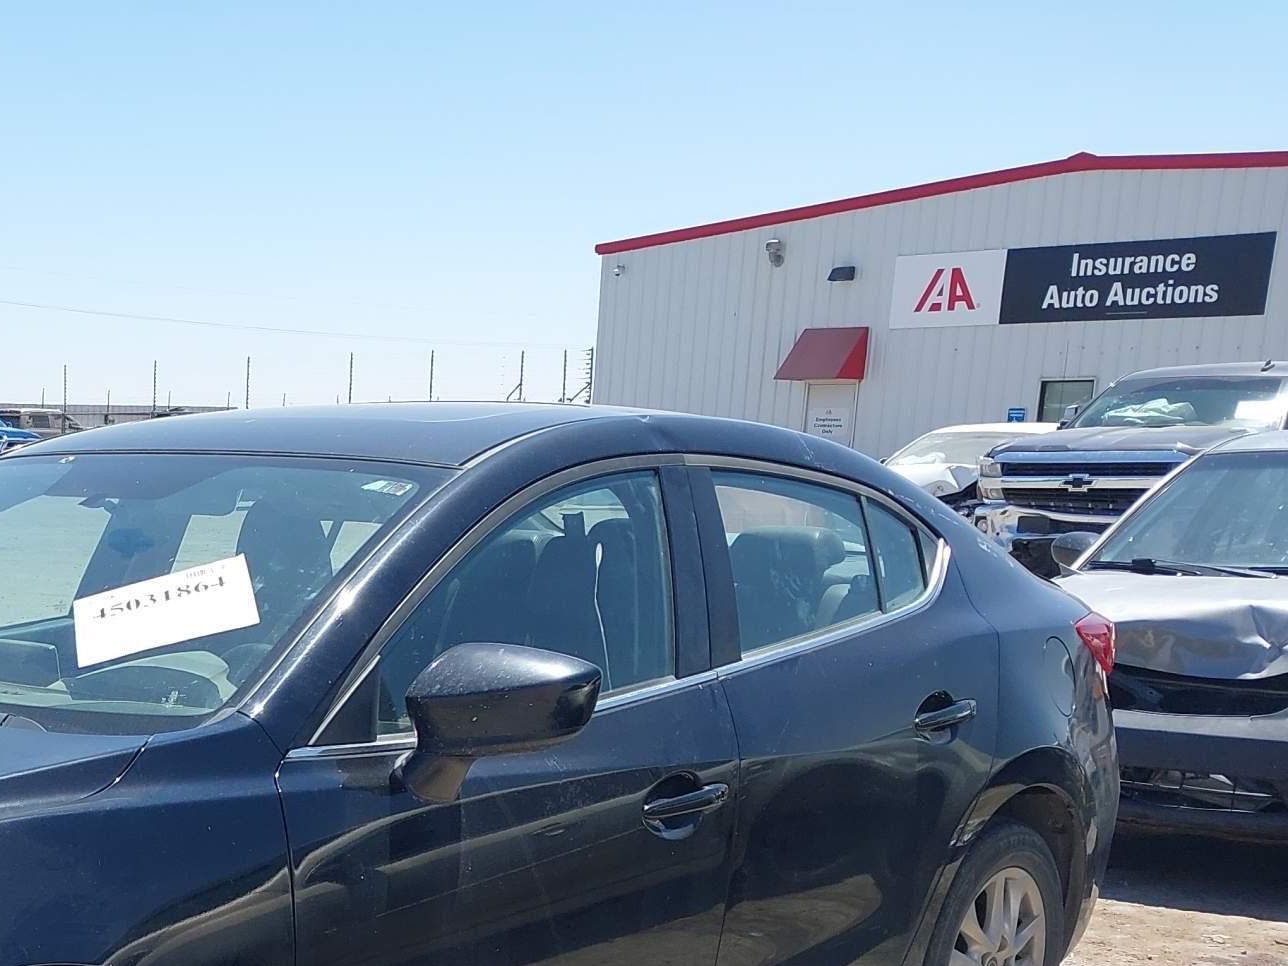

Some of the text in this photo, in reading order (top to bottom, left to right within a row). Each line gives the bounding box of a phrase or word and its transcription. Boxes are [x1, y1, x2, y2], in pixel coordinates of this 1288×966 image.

[1071, 252, 1197, 277] Insurance
[1041, 279, 1219, 309] Auto Auctions
[92, 576, 227, 619] 45031864
